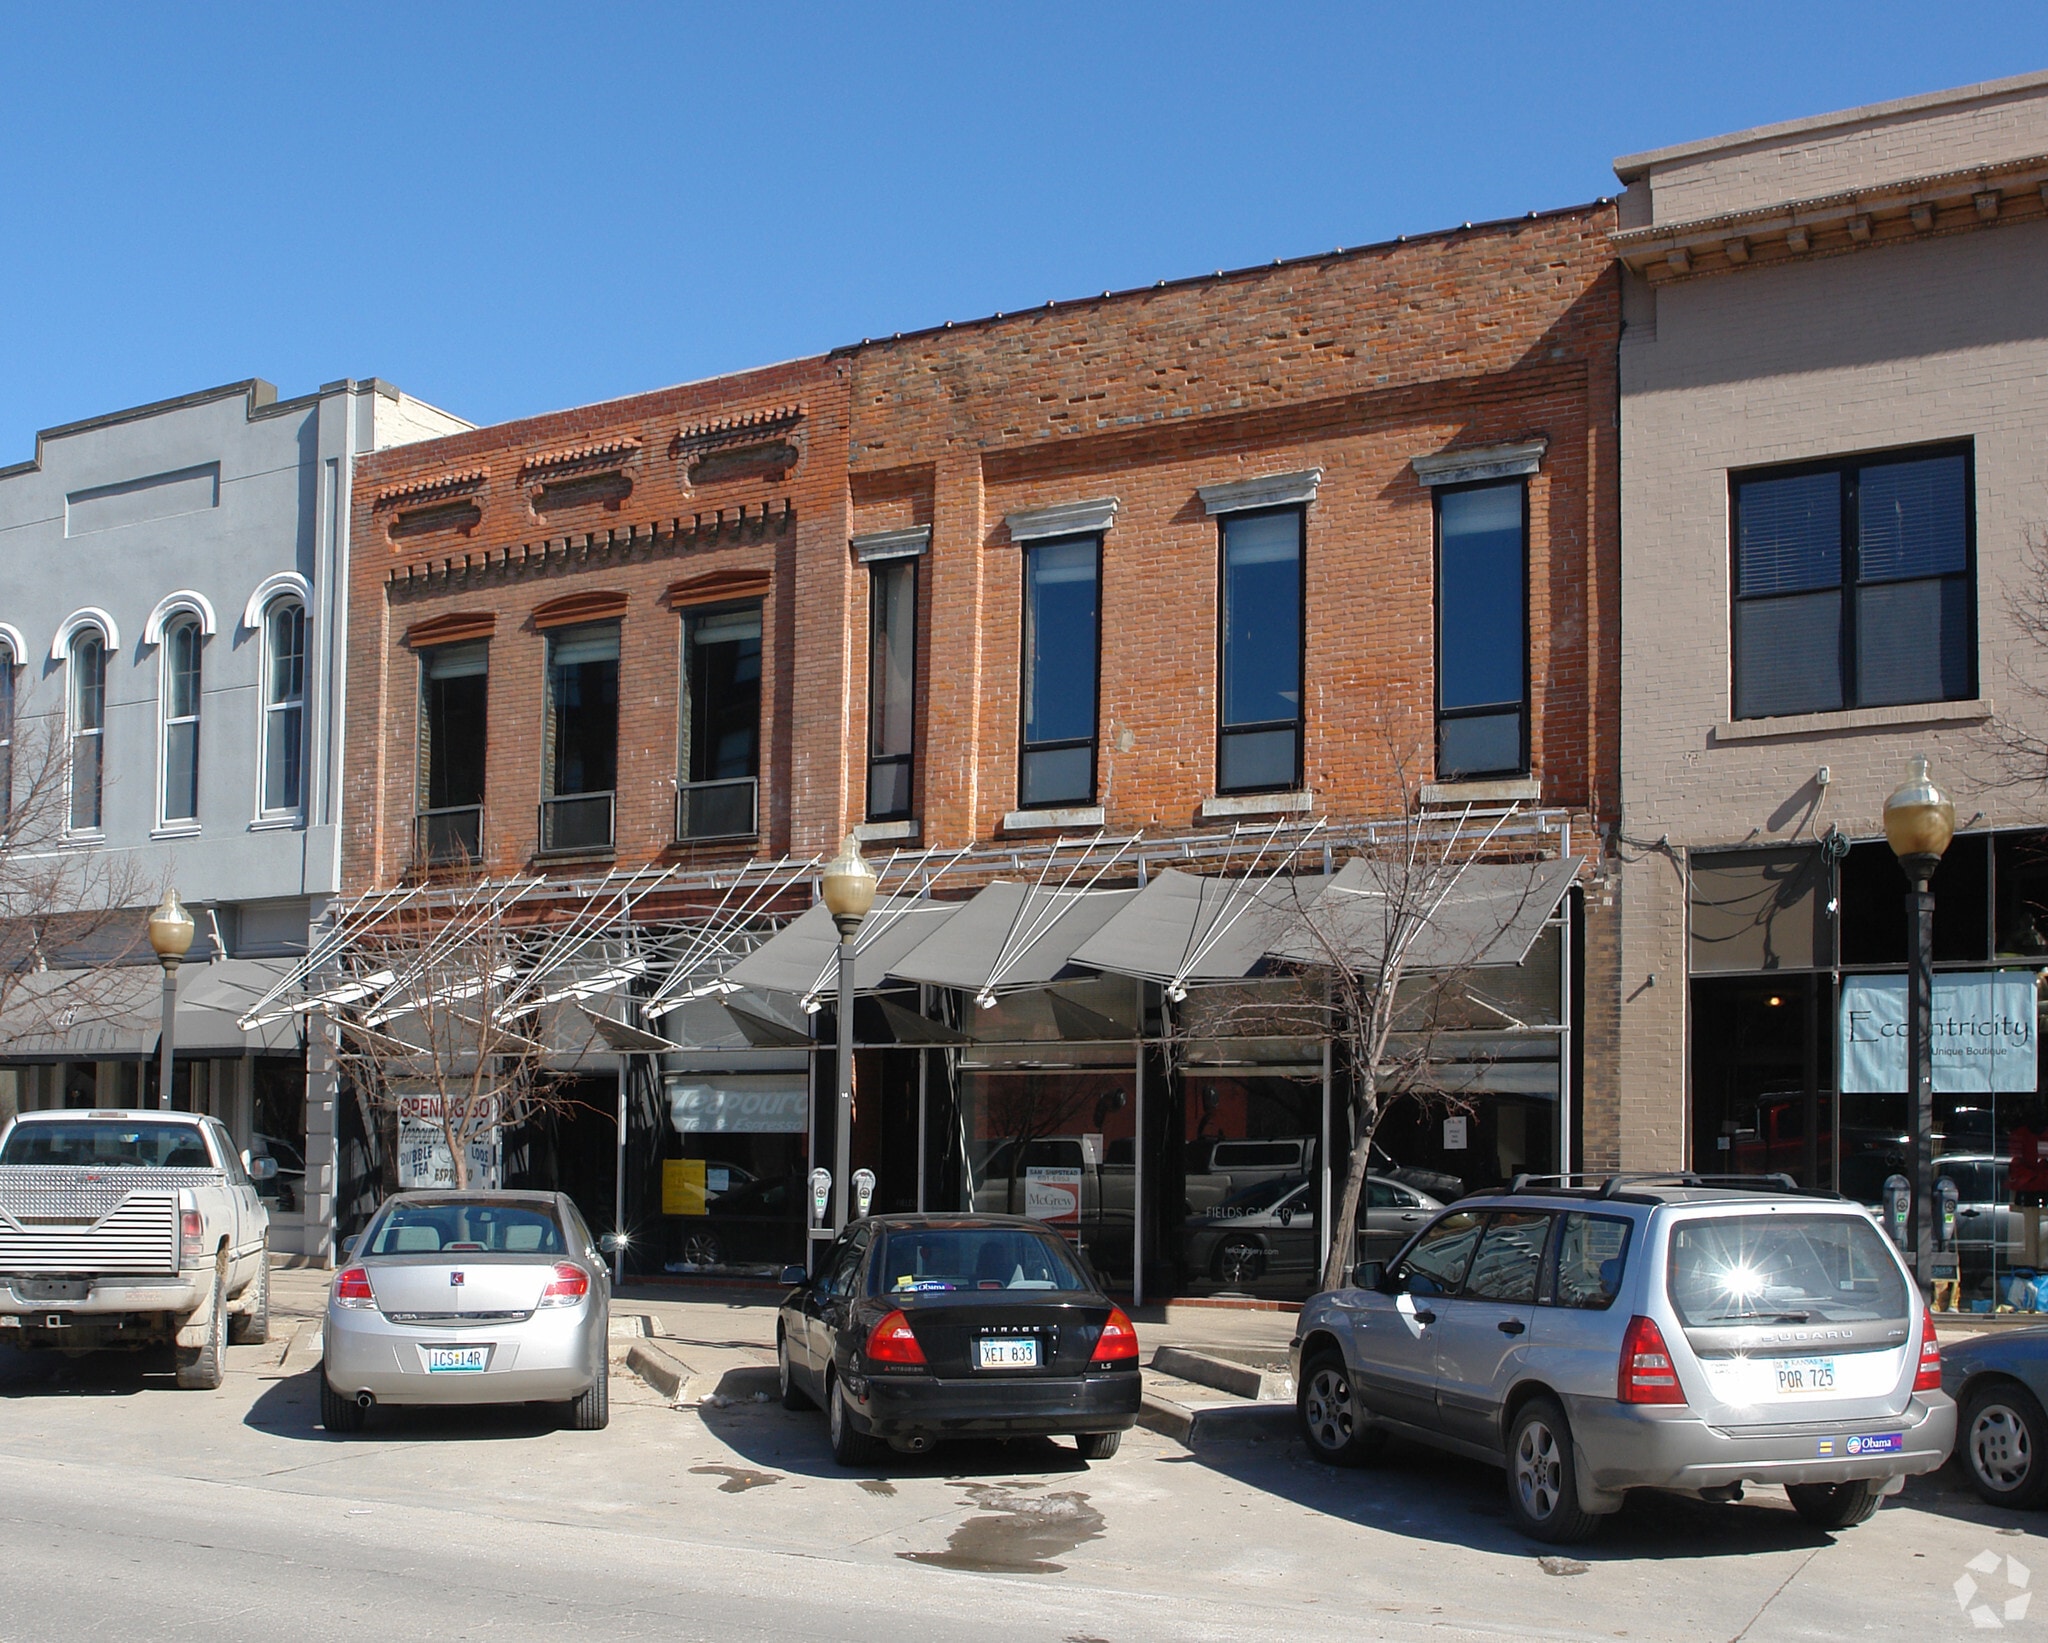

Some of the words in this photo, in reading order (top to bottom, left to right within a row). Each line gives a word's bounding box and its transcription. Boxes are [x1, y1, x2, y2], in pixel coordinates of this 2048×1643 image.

[1849, 1010, 2029, 1048] Eccntricity
[1932, 1047, 1963, 1057] Unique
[1966, 1046, 2007, 1057] Boutique
[682, 1117, 708, 1131] Tea
[731, 1117, 803, 1131] Espresso
[400, 1145, 432, 1166] BUBBLE
[412, 1161, 429, 1177] TEA
[1029, 1193, 1073, 1206] McGrew
[1206, 1206, 1243, 1219] FIELDS
[918, 1283, 945, 1291] Obama
[1762, 1329, 1854, 1343] SUBARU
[984, 1347, 1004, 1362] XEI
[1011, 1346, 1033, 1362] 833
[1779, 1370, 1804, 1388] POR
[1809, 1368, 1834, 1388] 725
[1862, 1436, 1892, 1449] Obama
